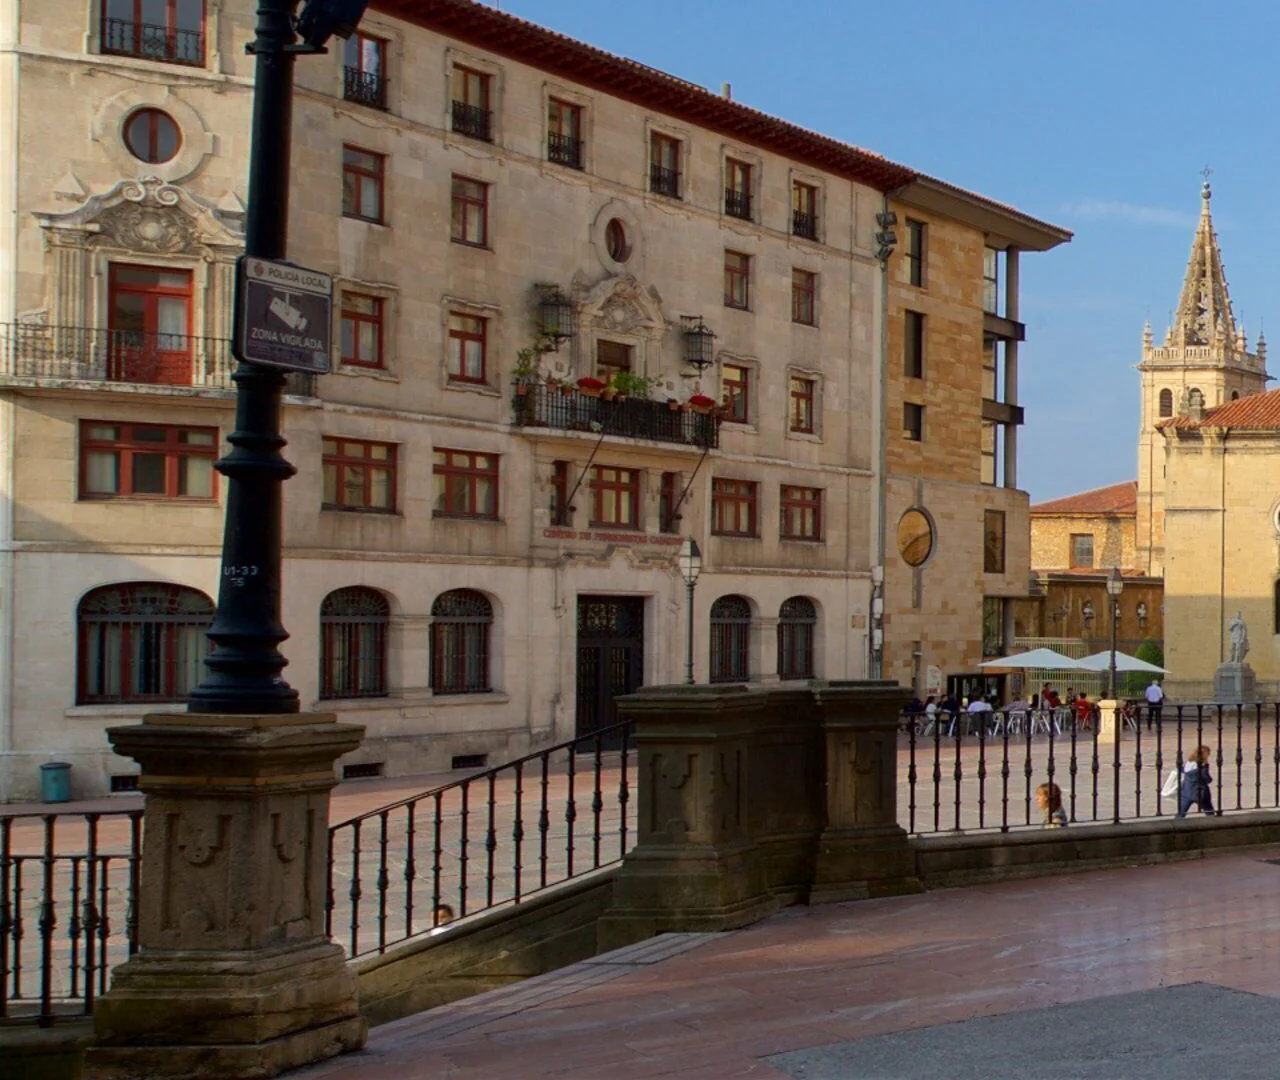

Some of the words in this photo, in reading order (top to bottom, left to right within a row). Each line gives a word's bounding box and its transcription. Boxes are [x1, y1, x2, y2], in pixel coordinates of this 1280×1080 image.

[268, 266, 299, 283] POLICÍA
[302, 275, 327, 289] LOCAL
[251, 327, 278, 342] ZONA
[280, 332, 324, 350] VIGILADA
